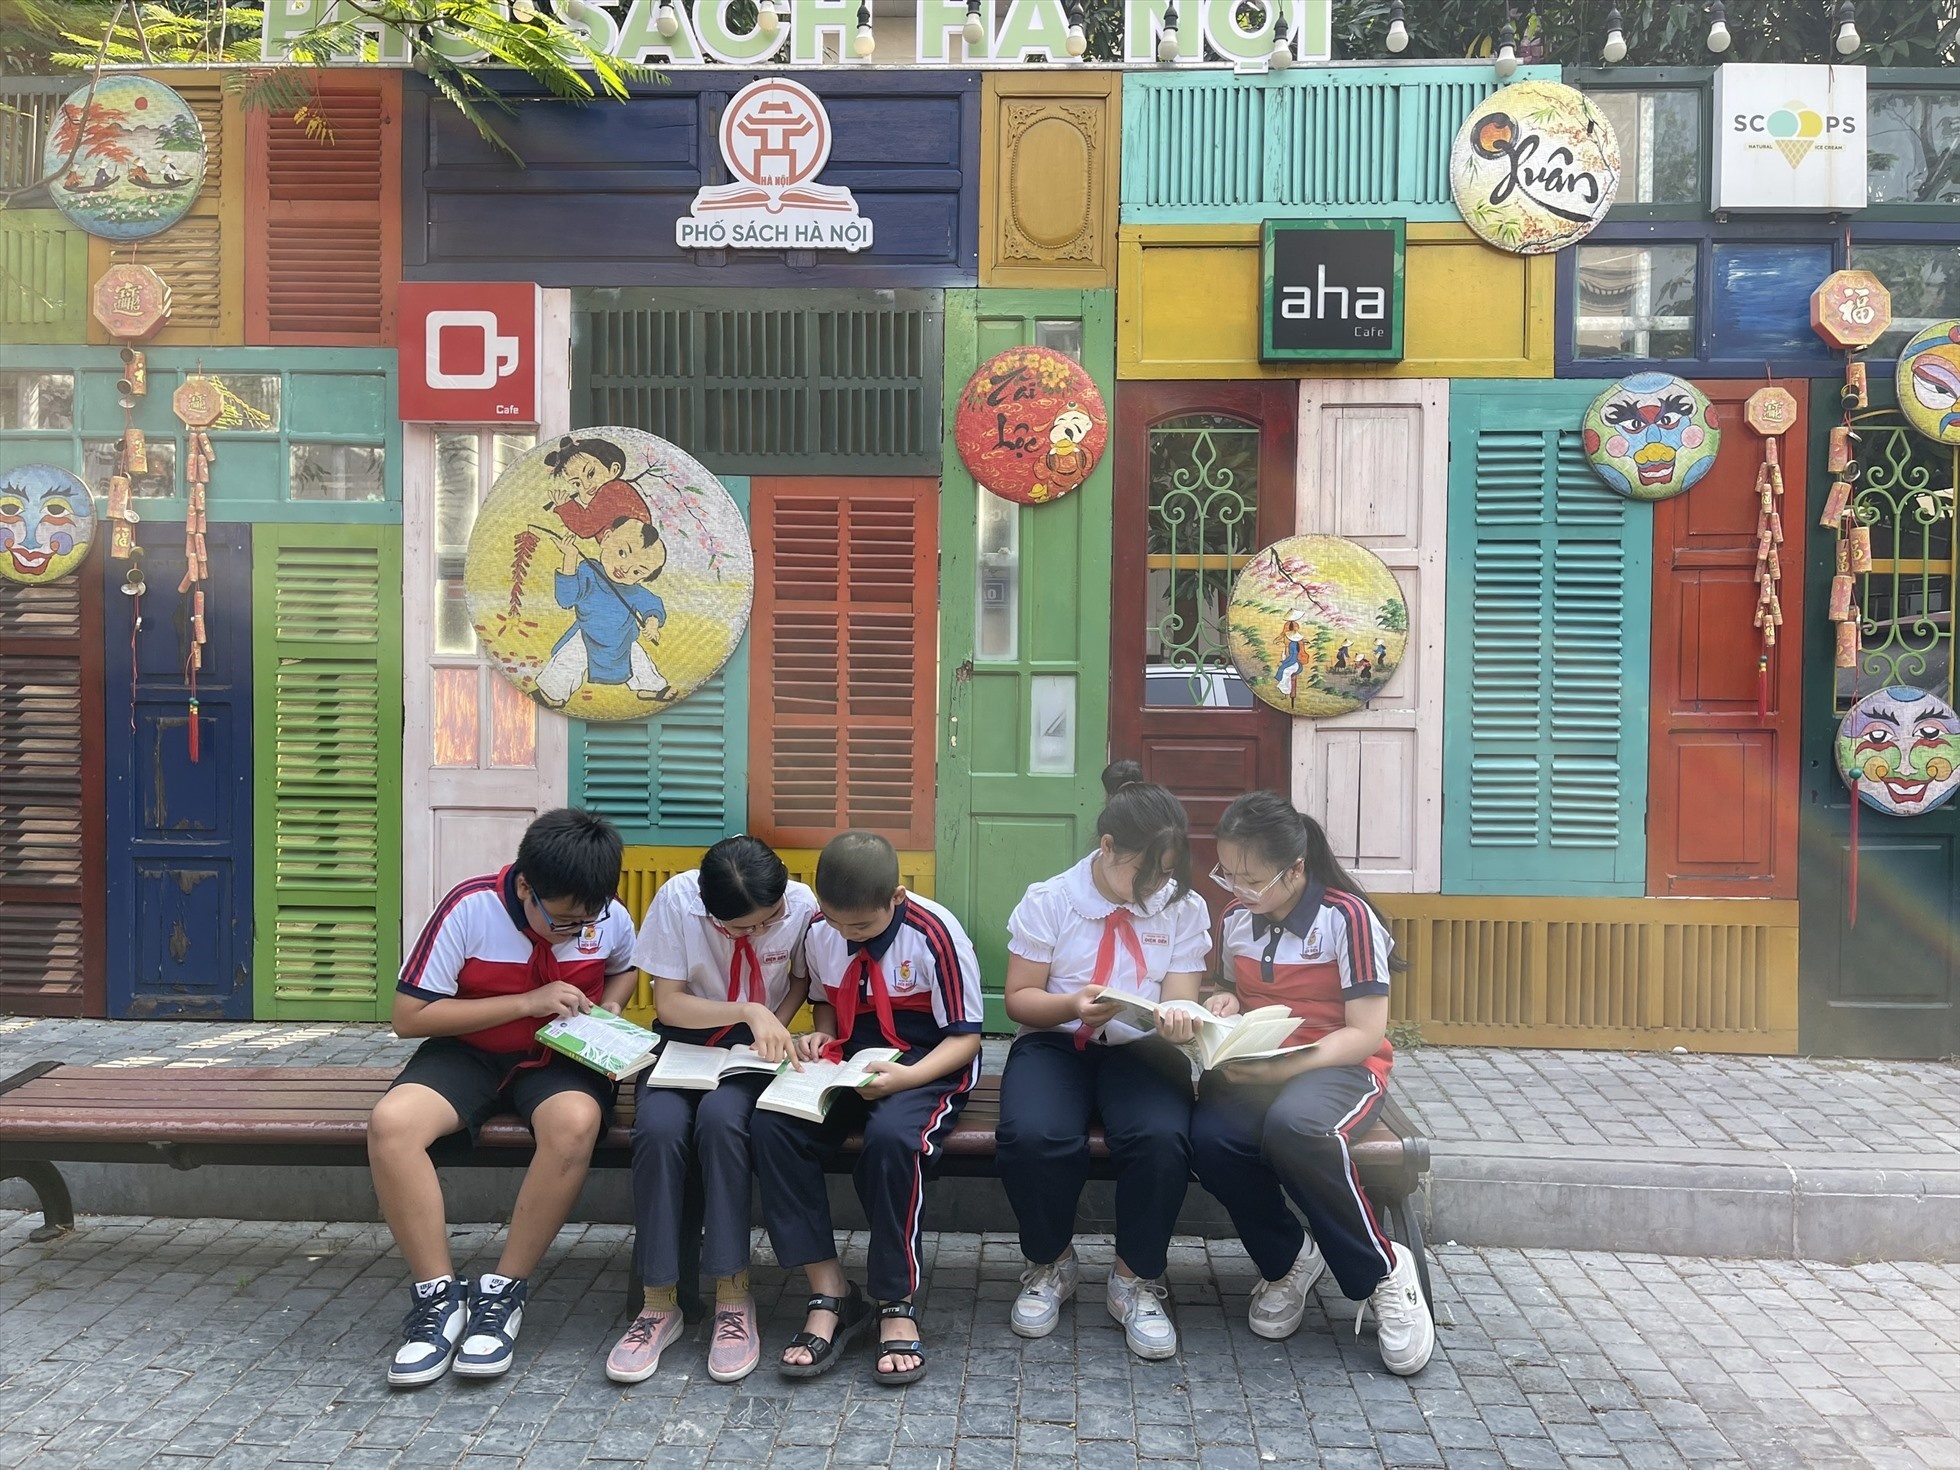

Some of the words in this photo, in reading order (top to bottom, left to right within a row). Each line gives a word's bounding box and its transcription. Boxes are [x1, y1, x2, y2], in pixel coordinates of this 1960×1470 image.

[761, 174, 773, 186] HÀ
[774, 174, 790, 188] NỘI
[681, 218, 726, 242] PHỐ
[732, 220, 788, 242] SÁCH
[795, 220, 824, 242] HÀ
[830, 222, 867, 247] NỘI
[1281, 264, 1385, 319] aha
[1838, 287, 1875, 325] 福
[1354, 326, 1384, 337] Cafe
[496, 404, 519, 415] Cafe
[992, 413, 1037, 458] Lộc
